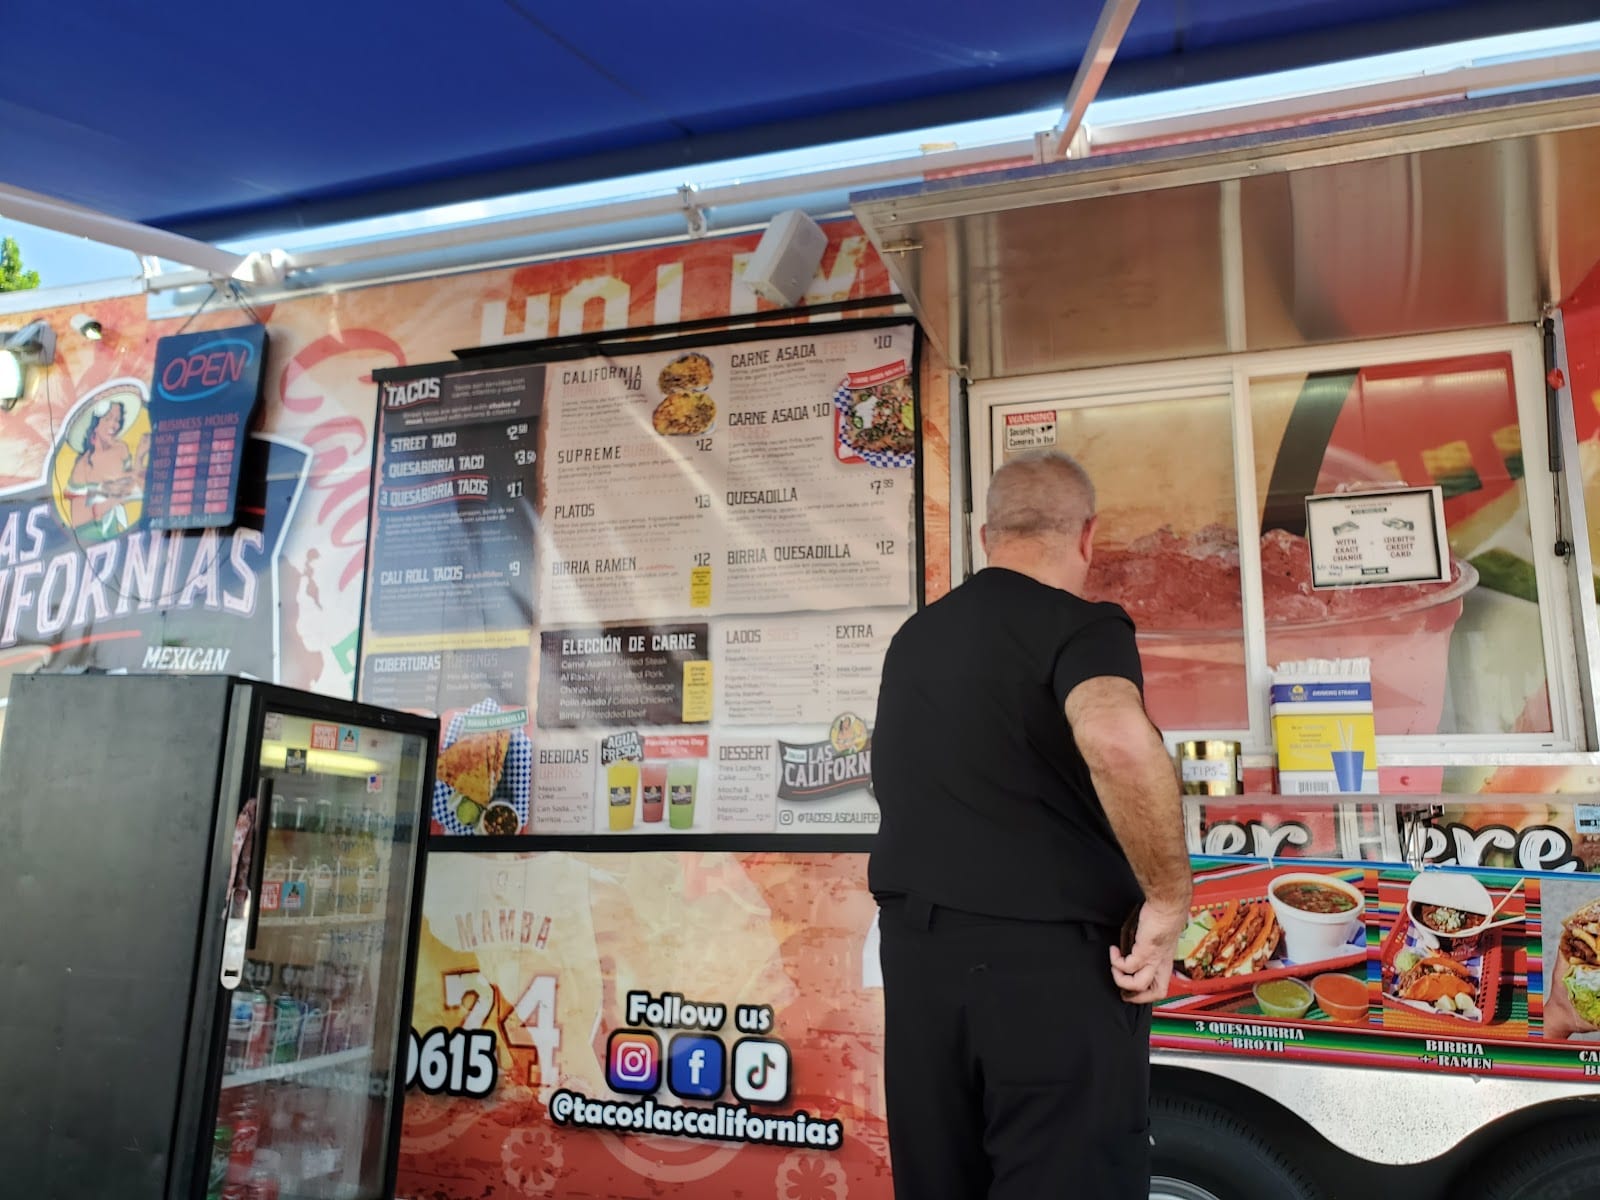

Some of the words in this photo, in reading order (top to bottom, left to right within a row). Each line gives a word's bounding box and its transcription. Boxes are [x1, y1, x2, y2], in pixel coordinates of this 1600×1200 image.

[874, 335, 892, 349] $10
[731, 350, 770, 368] CARNE
[776, 343, 816, 362] ASADA
[161, 351, 248, 392] OPEN
[563, 365, 643, 385] CALIFORNIA
[386, 377, 441, 407] TACOS
[624, 378, 642, 391] $10
[729, 411, 767, 426] CARNE
[772, 405, 809, 424] ASADA
[813, 402, 831, 418] $10
[158, 416, 202, 432] BUSINESS
[205, 412, 240, 427] HOURS
[1010, 427, 1035, 437] Security
[391, 435, 427, 452] STREET
[431, 432, 457, 449] TACO
[696, 438, 713, 452] $12
[558, 446, 622, 464] SUPREME
[389, 460, 455, 478] QUESABIRRIA
[458, 454, 485, 471] TACO
[380, 491, 389, 505] 3
[390, 482, 454, 506] QUESABIRRIA
[457, 479, 489, 495] TACOS
[726, 487, 798, 506] QUESADILLA
[554, 503, 595, 520] PLATOS
[727, 547, 768, 565] BIRRIA
[774, 544, 851, 561] QUESADILLA
[876, 540, 894, 555] $12
[552, 560, 590, 576] BIRRIA
[595, 557, 637, 574] RAMEN
[694, 552, 711, 567] $12
[380, 570, 403, 585] CALI
[405, 568, 429, 585] ROLL
[432, 565, 464, 581] TACOS
[726, 629, 761, 645] LADOS
[836, 624, 874, 639] EXTRA
[628, 636, 646, 652] DE
[651, 633, 696, 651] CARNE
[142, 646, 230, 672] MEXICAN
[374, 655, 441, 673] COBERTURAS
[607, 732, 638, 749] AGUA
[540, 749, 589, 764] BEBIDAS
[602, 744, 642, 761] FRESCA
[720, 745, 771, 761] DESSERT
[808, 745, 833, 764] LAS
[1190, 765, 1217, 778] TIPS
[455, 909, 552, 949] MAMBA
[628, 994, 724, 1026] Follow
[738, 1006, 770, 1031] us
[1195, 1021, 1206, 1032] 3
[1209, 1022, 1305, 1041] QUESABIRRIA
[1232, 1038, 1285, 1053] BROTH
[1425, 1040, 1484, 1056] BIRRIA
[1437, 1055, 1493, 1070] RAMEN
[1579, 1050, 1600, 1063] CA
[1584, 1065, 1600, 1076] B
[552, 1093, 841, 1147] @tacoslascalifornias
